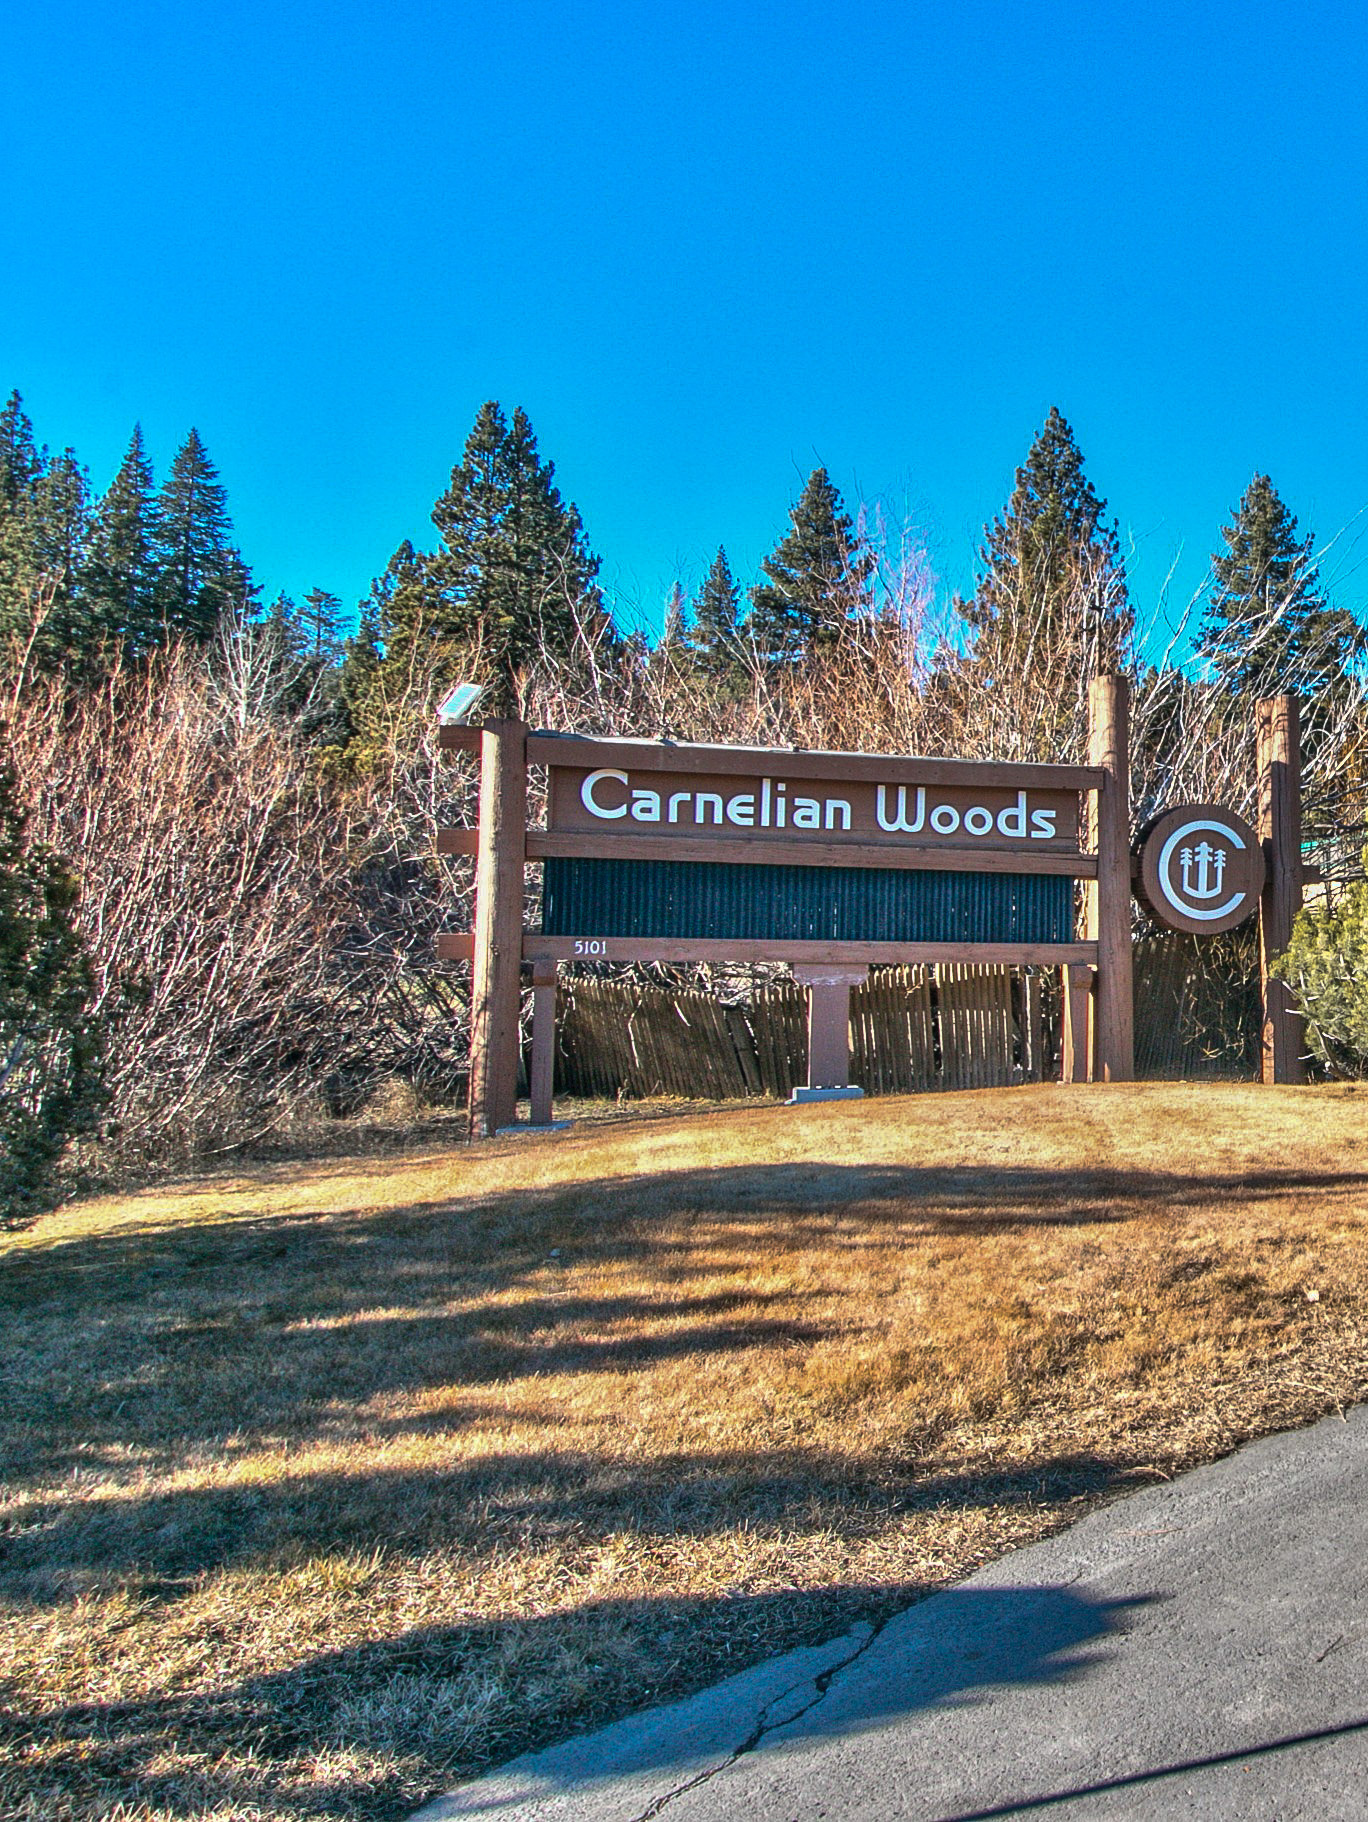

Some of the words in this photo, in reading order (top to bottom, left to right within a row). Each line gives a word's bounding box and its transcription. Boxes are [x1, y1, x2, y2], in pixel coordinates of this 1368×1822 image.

[580, 769, 852, 831] Carnelian
[876, 785, 1058, 840] Woods
[574, 940, 607, 955] 5101
